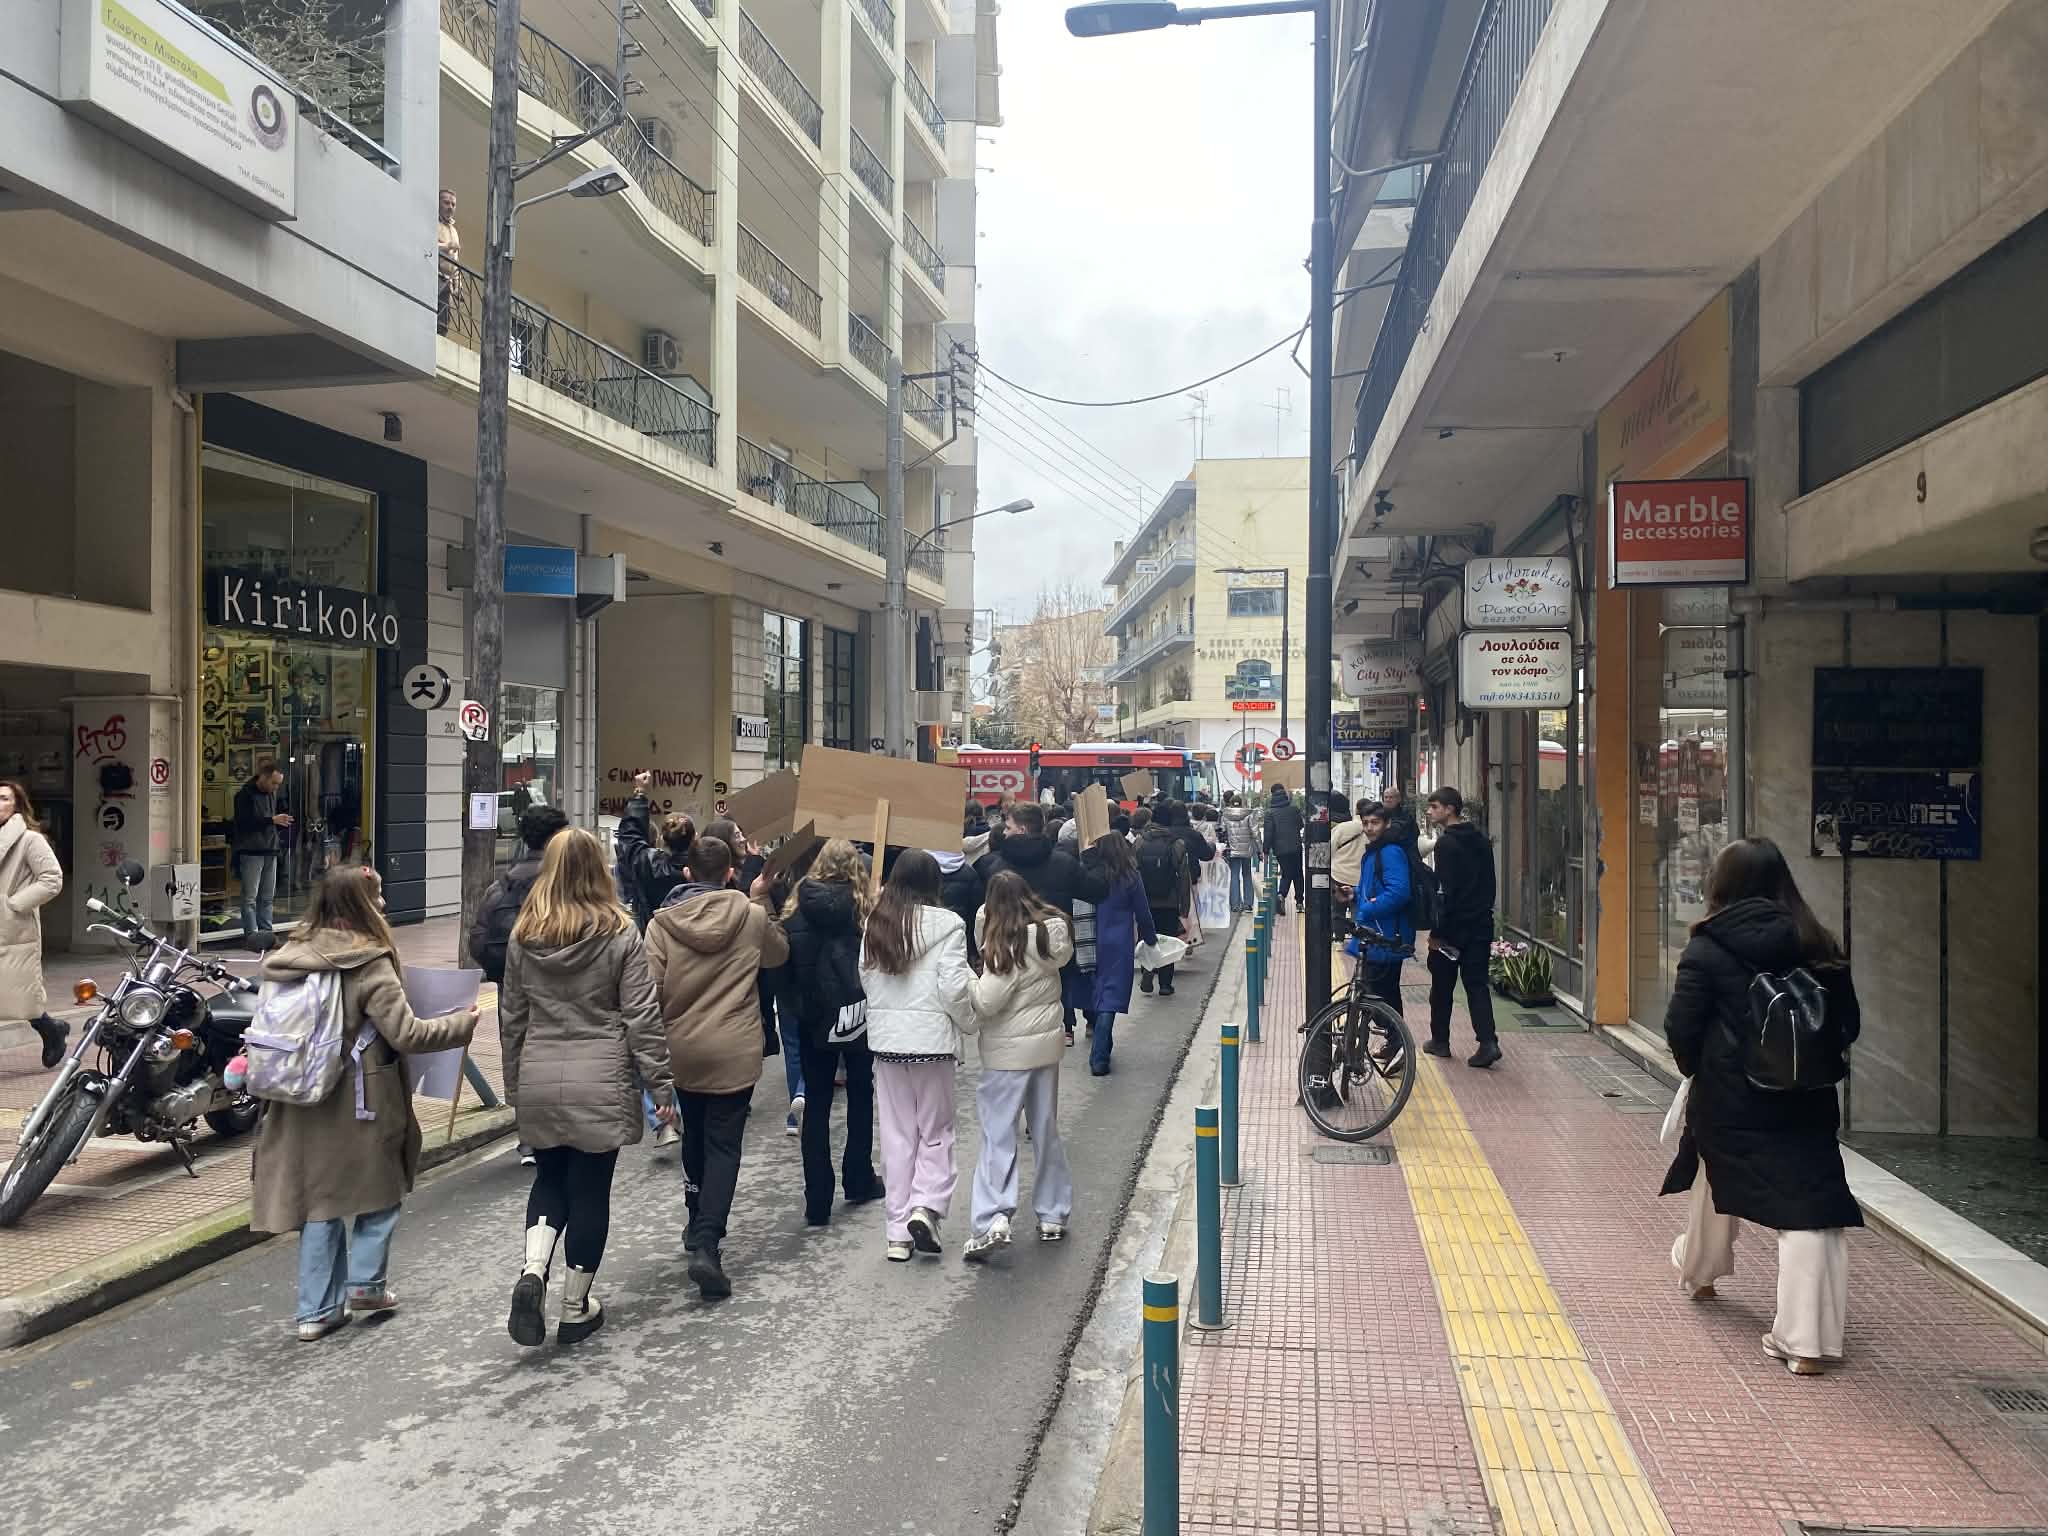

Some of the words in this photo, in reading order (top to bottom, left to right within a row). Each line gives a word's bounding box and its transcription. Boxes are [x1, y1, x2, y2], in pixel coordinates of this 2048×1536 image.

[1916, 471, 1927, 504] 9
[1623, 496, 1741, 524] Marble
[1622, 520, 1741, 541] accessories
[224, 575, 399, 645] Kirikoko
[1479, 638, 1560, 652] Λουλούδια
[1501, 656, 1515, 664] σε
[1517, 653, 1539, 664] όλο
[1357, 668, 1379, 683] City
[1491, 668, 1511, 676] τον
[1513, 666, 1548, 677] κόσμο
[444, 722, 456, 733] 20
[652, 768, 703, 793] ΠΑΝΤΟΥ
[836, 998, 867, 1033] NIK
